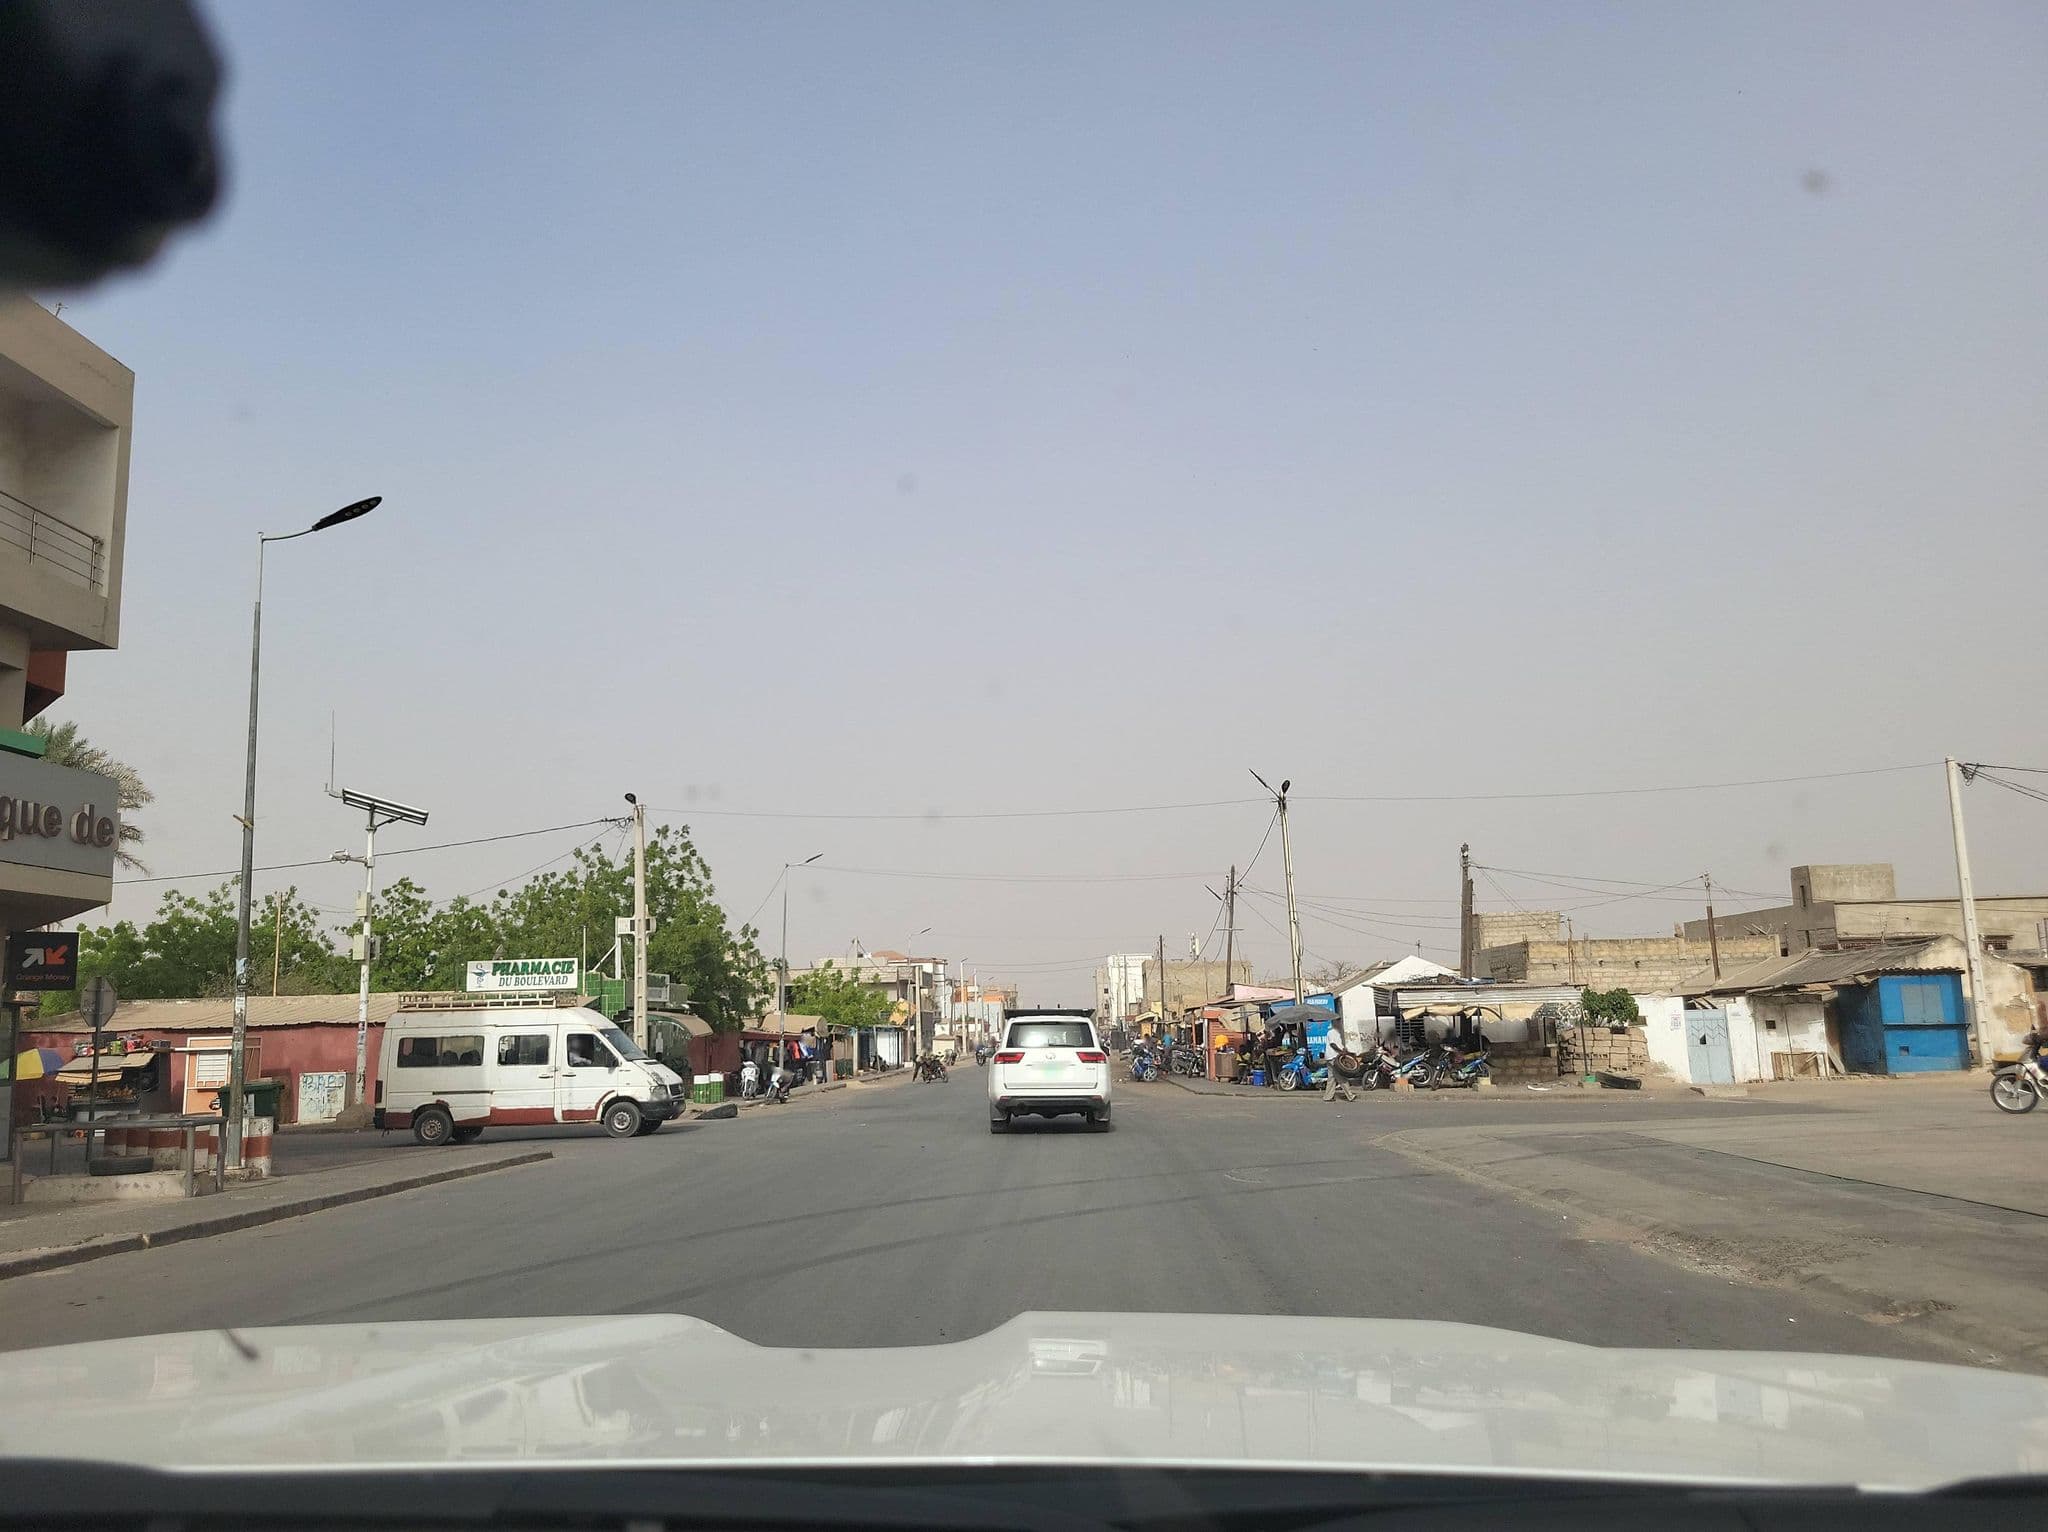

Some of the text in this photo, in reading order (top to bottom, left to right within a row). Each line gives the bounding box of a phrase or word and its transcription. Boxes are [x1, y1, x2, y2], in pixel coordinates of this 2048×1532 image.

[70, 804, 114, 848] de
[491, 960, 575, 976] PHARMACIE
[498, 976, 568, 987] DU BOULEVARD
